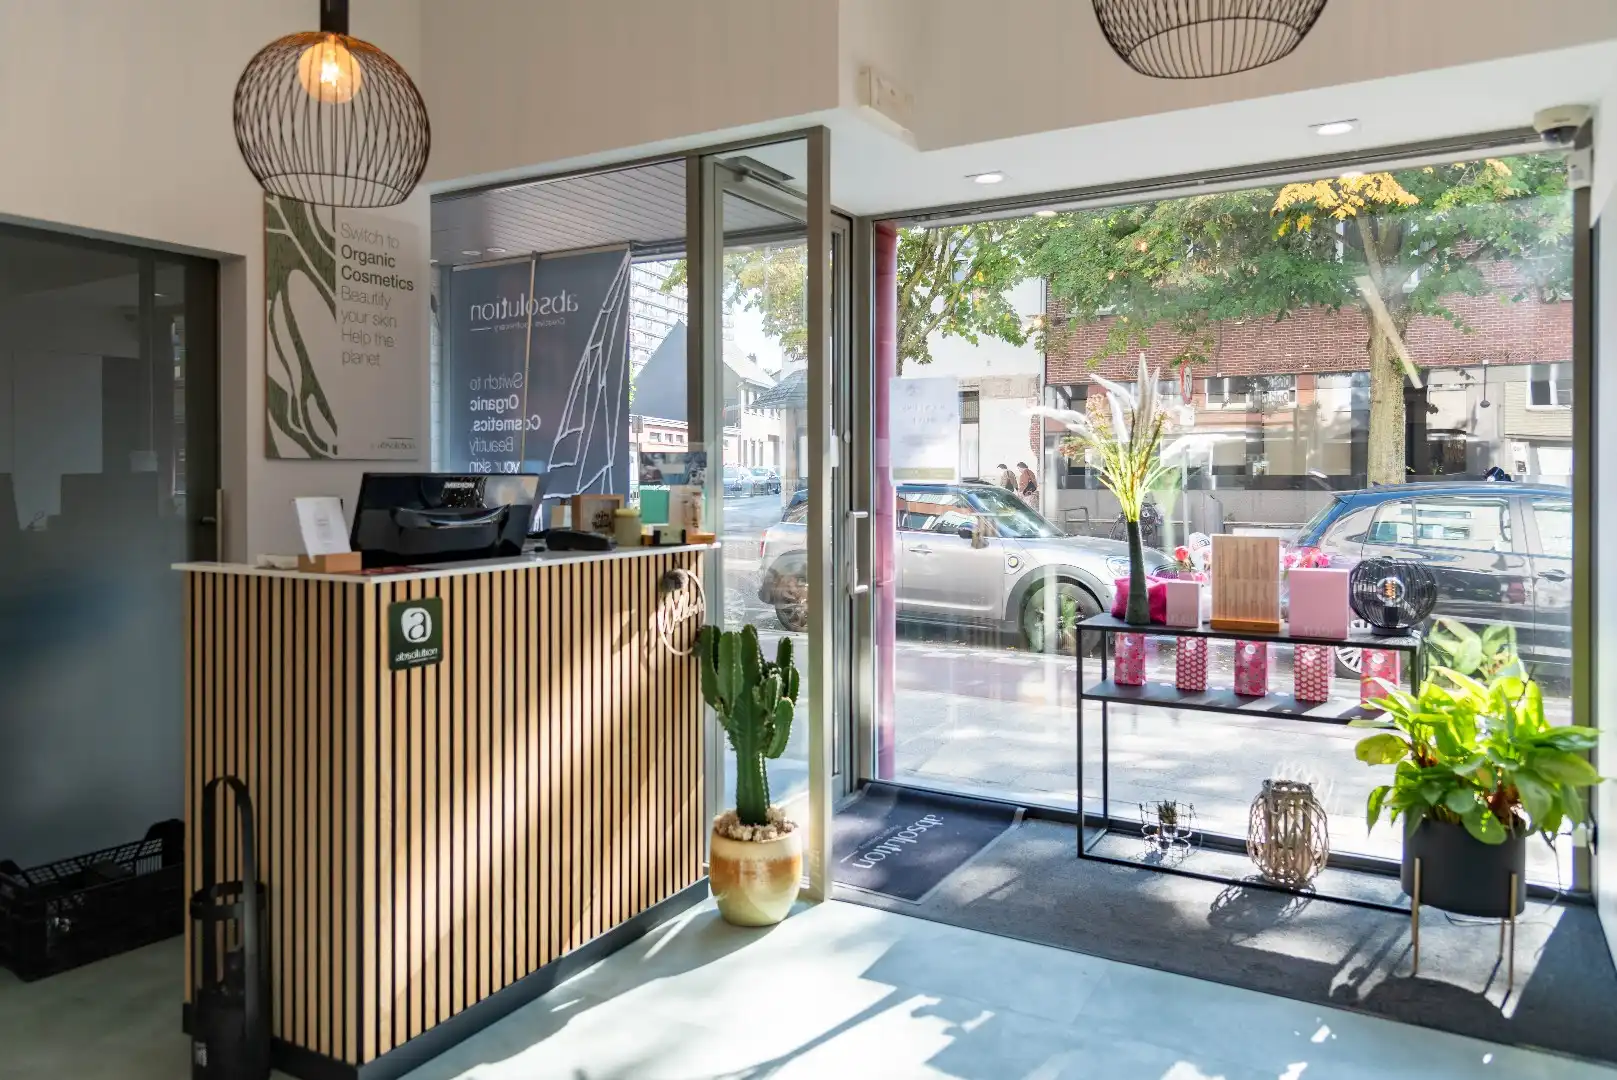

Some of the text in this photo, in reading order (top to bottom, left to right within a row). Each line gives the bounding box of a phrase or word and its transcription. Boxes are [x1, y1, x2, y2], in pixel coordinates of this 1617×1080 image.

[341, 222, 400, 249] Switch to
[341, 244, 396, 269] Organic
[341, 265, 414, 291] Cosmetics
[342, 285, 391, 310] Beautify
[341, 309, 397, 328] your skin
[342, 327, 394, 347] Help the
[342, 349, 380, 366] planet
[852, 814, 944, 869] absolution
